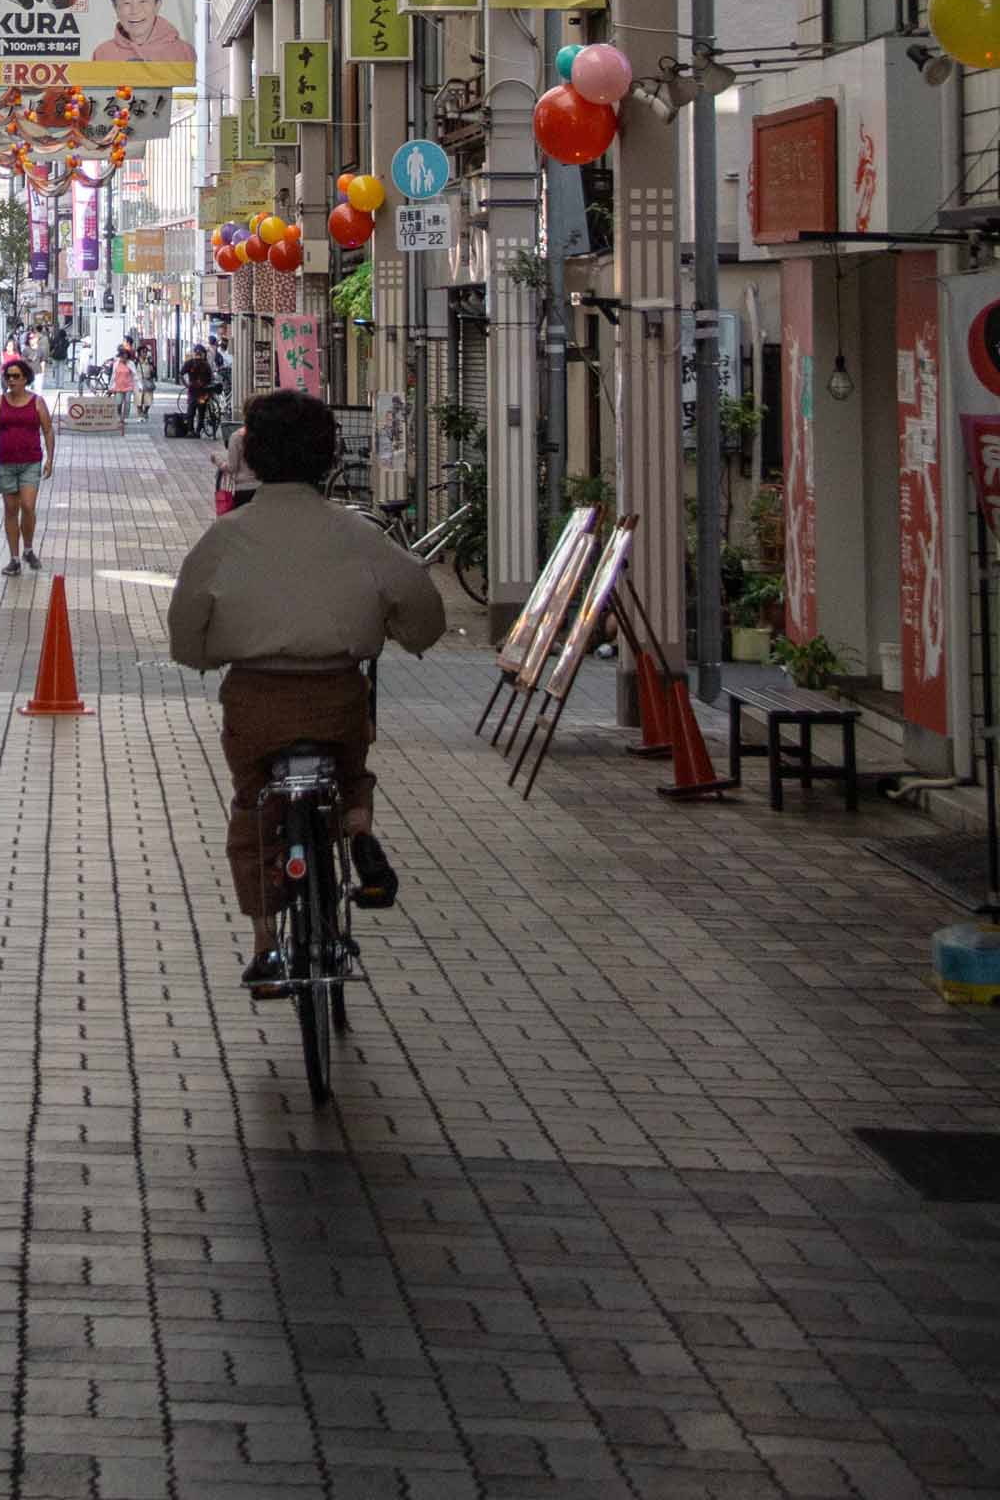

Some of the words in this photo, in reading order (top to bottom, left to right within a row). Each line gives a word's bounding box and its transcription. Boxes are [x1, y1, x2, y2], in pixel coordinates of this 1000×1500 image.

[14, 63, 69, 85] ROX
[399, 209, 422, 222] 自転車
